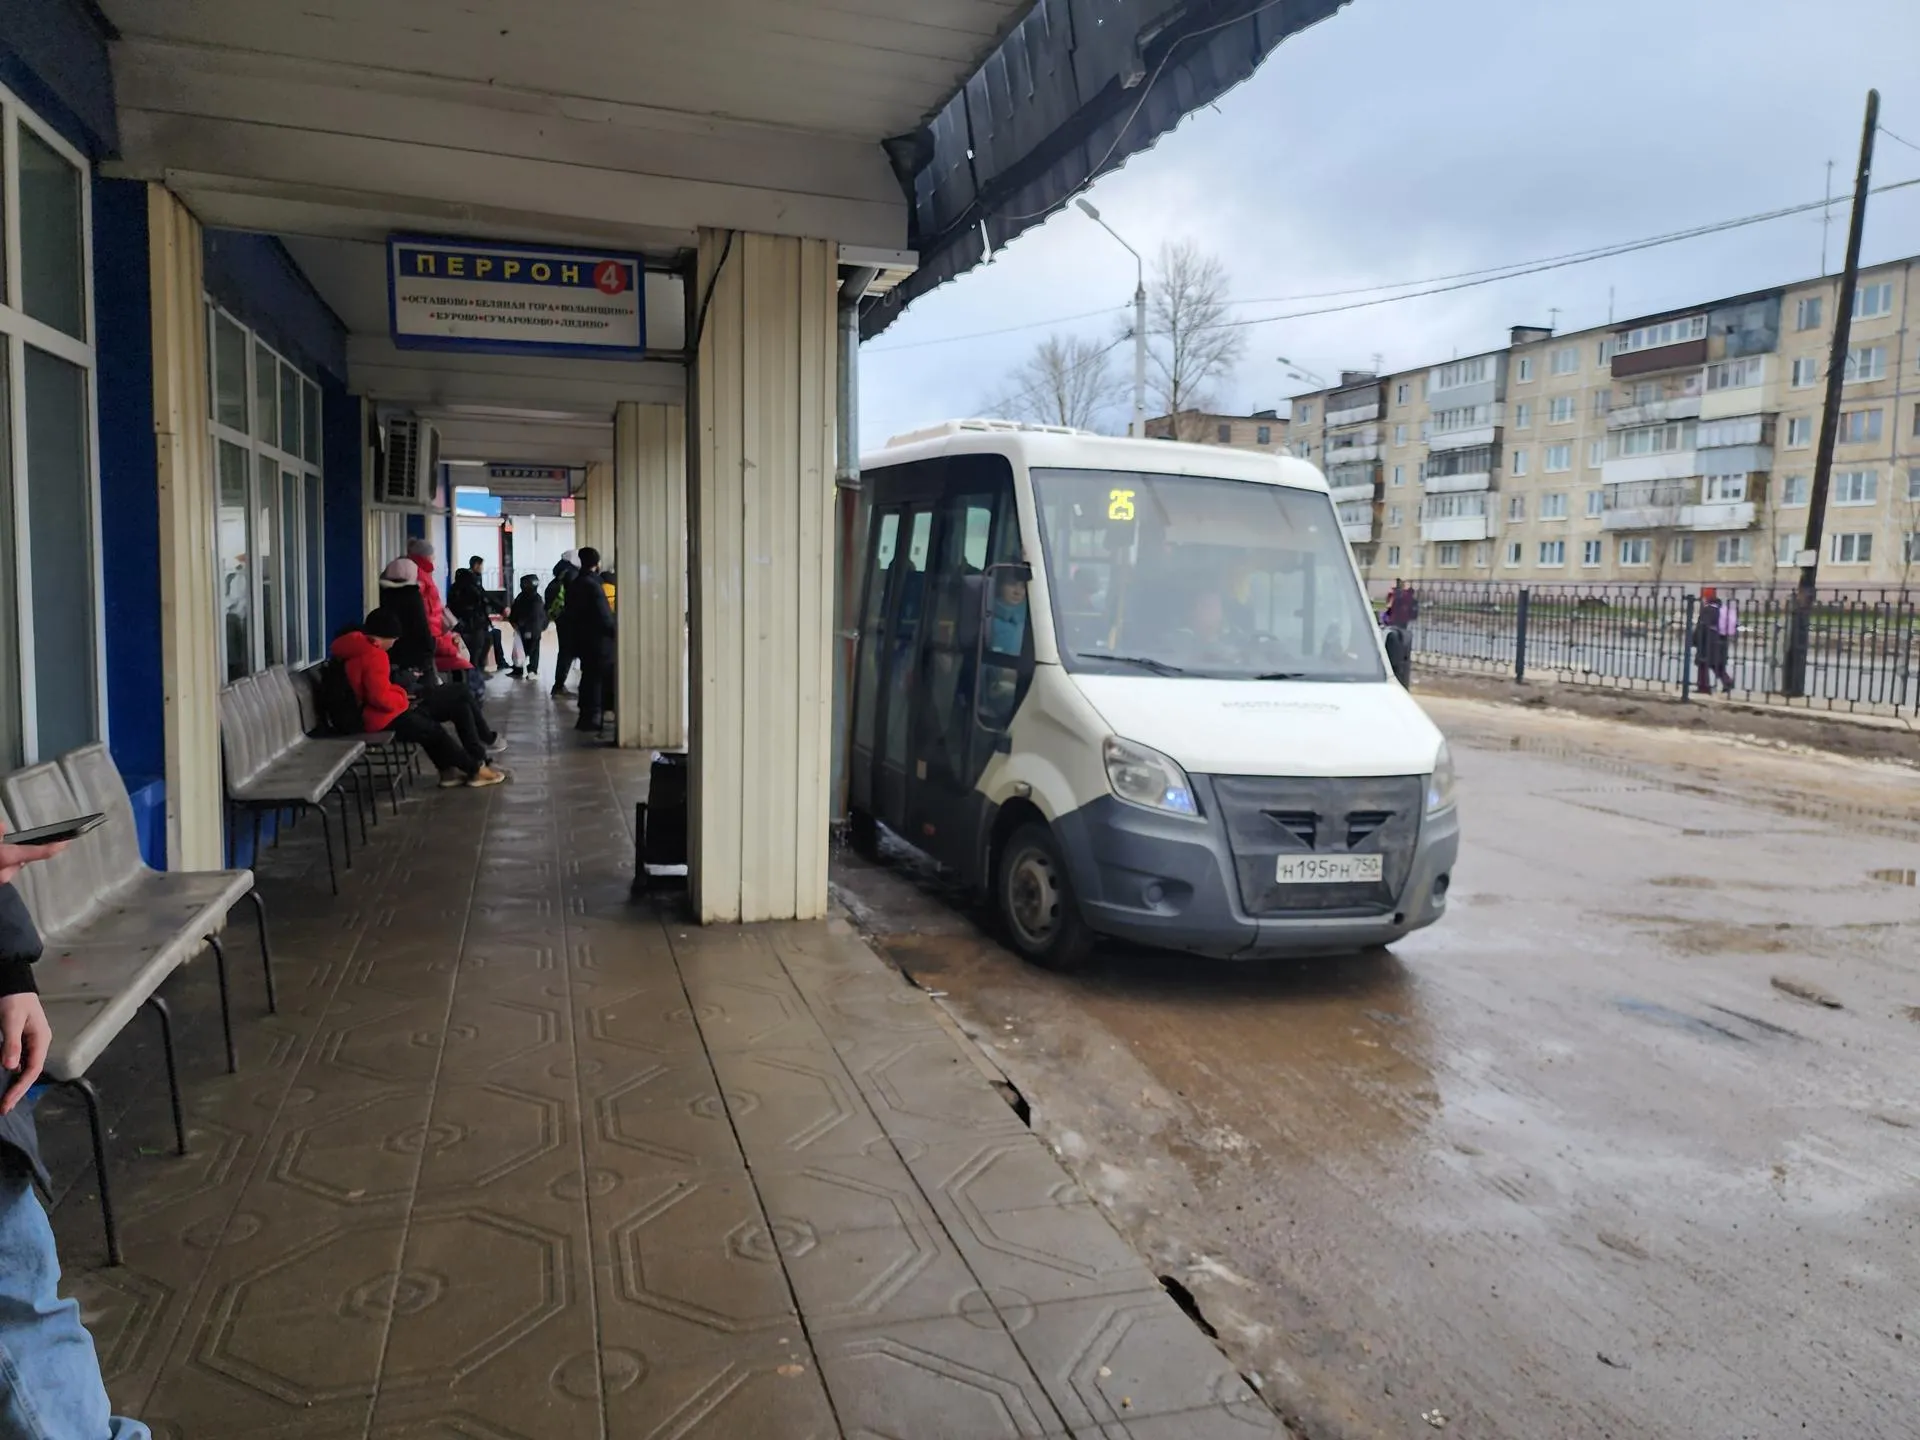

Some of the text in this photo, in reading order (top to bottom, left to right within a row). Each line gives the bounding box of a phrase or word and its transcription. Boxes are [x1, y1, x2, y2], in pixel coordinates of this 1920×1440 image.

[416, 254, 620, 290] ПЕРРОН 4
[408, 294, 468, 306] ОСТАШОВО
[528, 302, 555, 312] ГОРА
[436, 312, 479, 322] КУРОВО
[484, 313, 554, 327] СУМАРОКОВО
[1109, 489, 1136, 521] 25
